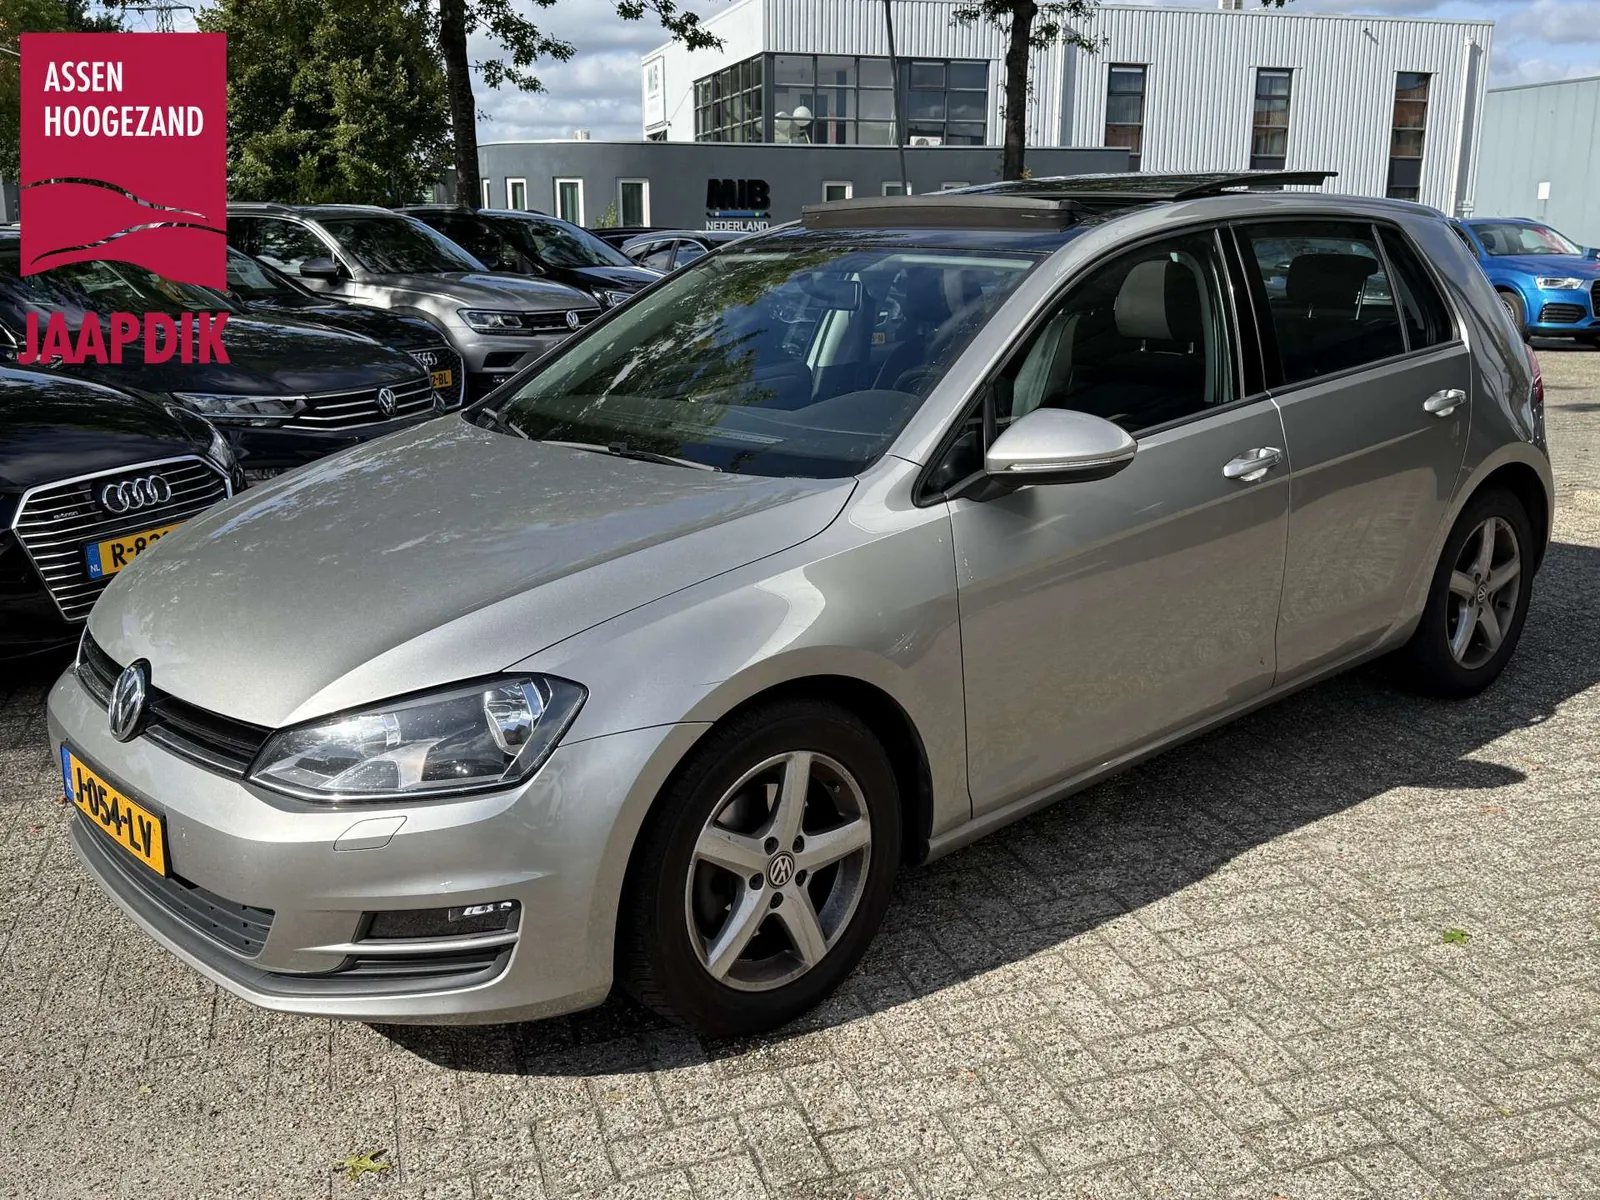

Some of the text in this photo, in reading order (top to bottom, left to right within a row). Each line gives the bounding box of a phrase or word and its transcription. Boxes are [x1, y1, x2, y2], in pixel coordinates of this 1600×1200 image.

[706, 178, 771, 211] MIB
[705, 221, 769, 232] NEDERLAND
[90, 564, 100, 573] NL
[76, 767, 151, 858] J-054-LV
